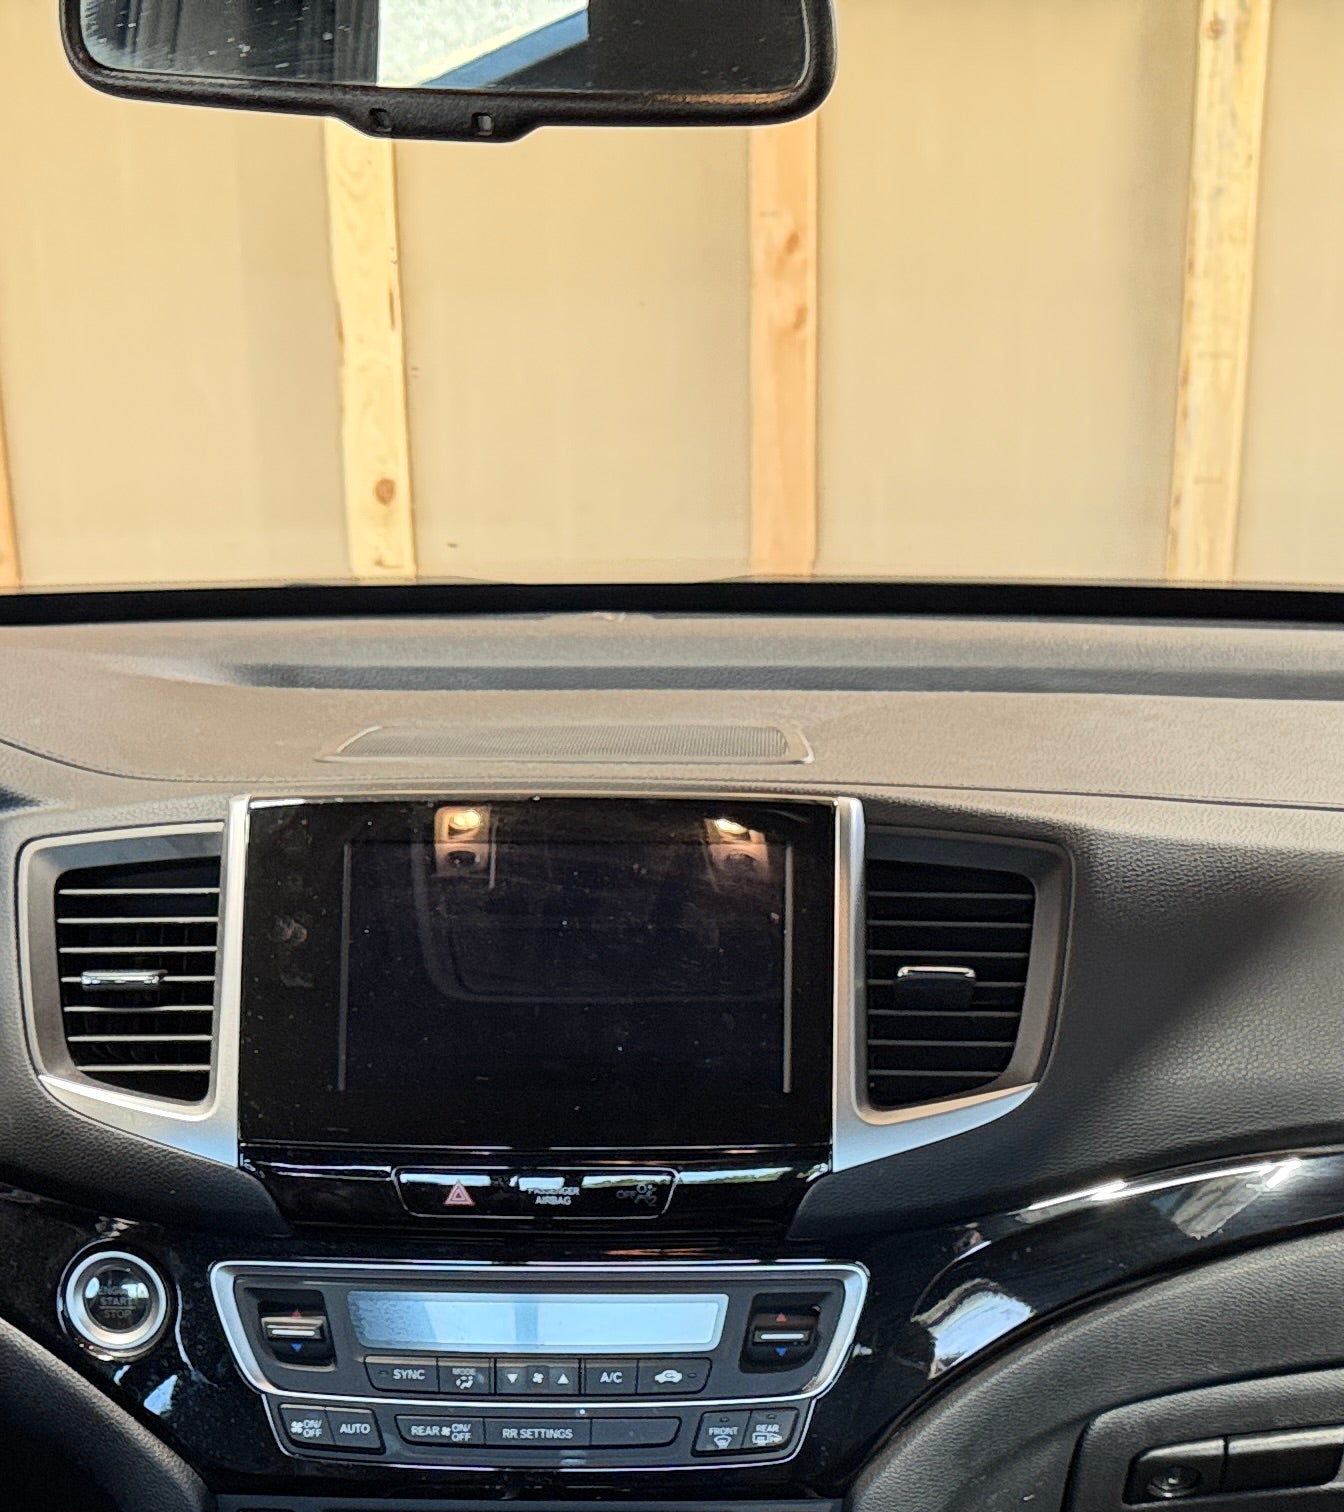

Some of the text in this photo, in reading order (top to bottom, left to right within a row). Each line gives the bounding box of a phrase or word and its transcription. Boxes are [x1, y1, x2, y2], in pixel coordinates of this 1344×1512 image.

[535, 1196, 572, 1206] AIRBAG
[99, 1296, 134, 1306] START
[103, 1309, 133, 1319] STOP
[393, 1368, 426, 1380] SYNC
[599, 1371, 623, 1384] A/C
[302, 1428, 323, 1438] OFF
[339, 1423, 371, 1434] AUTO
[410, 1425, 440, 1436] REAR
[708, 1426, 739, 1436] FRONT
[755, 1423, 780, 1433] REAR
[451, 1432, 471, 1442] OFF
[502, 1428, 573, 1439] RR SETTINGS
